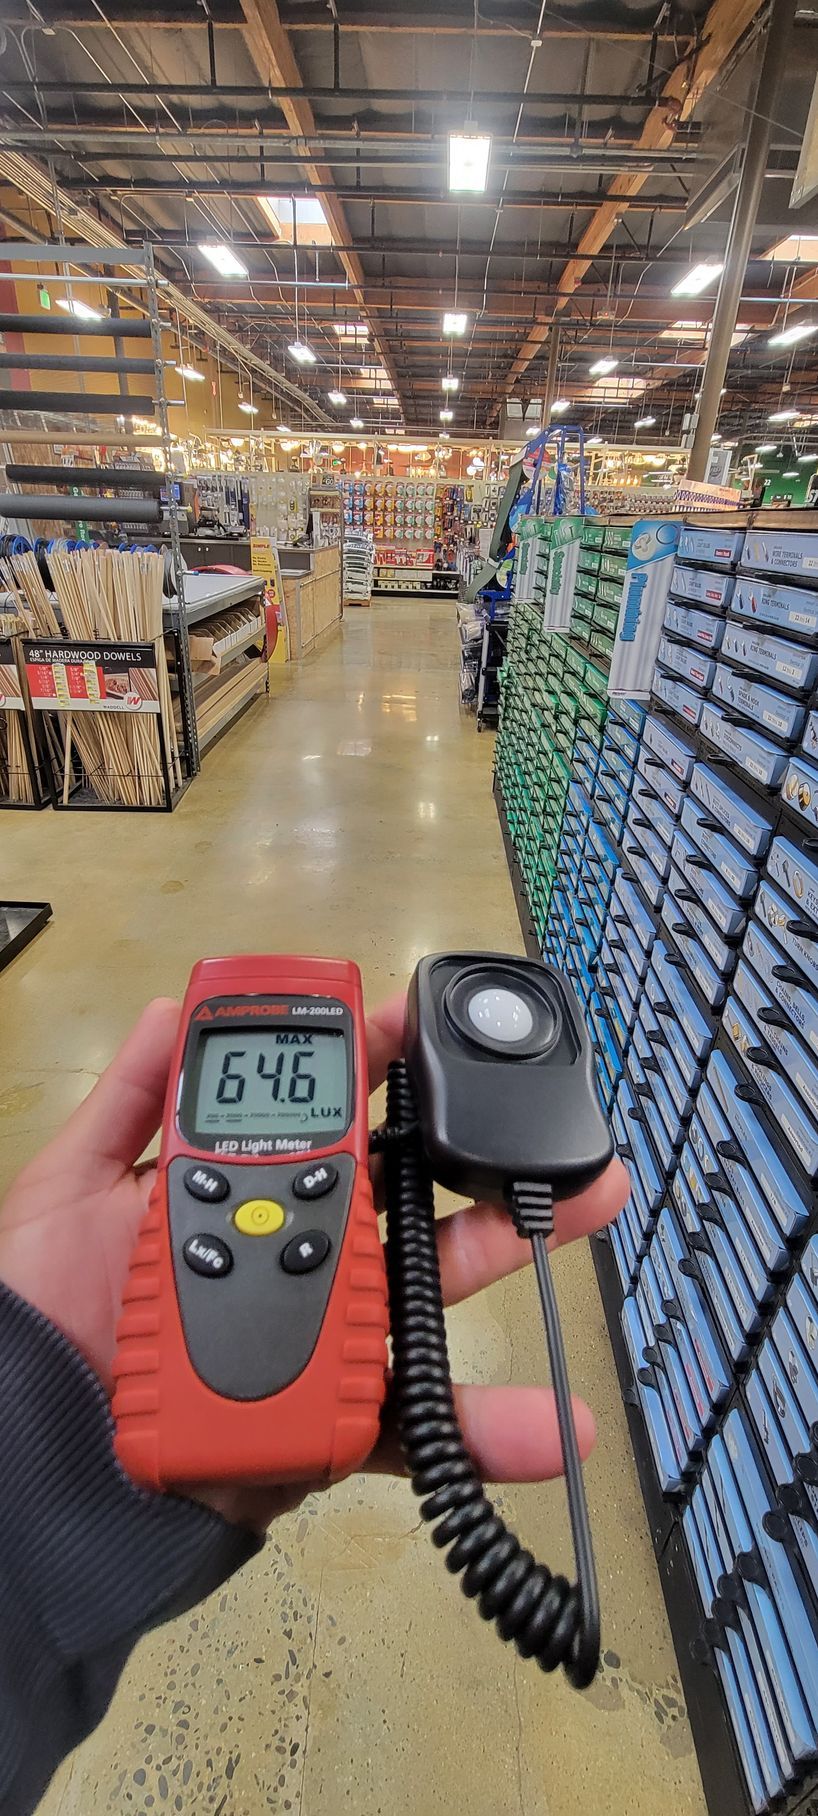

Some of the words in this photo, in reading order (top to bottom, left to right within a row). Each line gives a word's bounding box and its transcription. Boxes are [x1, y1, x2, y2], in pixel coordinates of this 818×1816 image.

[619, 573, 649, 641] Plumbing
[29, 650, 43, 658] 48"
[45, 650, 101, 660] HARDWOOD
[103, 651, 142, 662] DOWELS
[215, 1004, 289, 1017] AMPROBE
[291, 1006, 344, 1016] LM-200LED
[275, 1034, 313, 1044] MAX
[216, 1050, 317, 1103] 64.6
[310, 1106, 342, 1118] LUX
[215, 1140, 239, 1151] LED
[241, 1139, 273, 1152] Light
[275, 1138, 313, 1151] Meter
[191, 1170, 219, 1193] M-H
[302, 1167, 328, 1189] D-H
[298, 1242, 314, 1259] R
